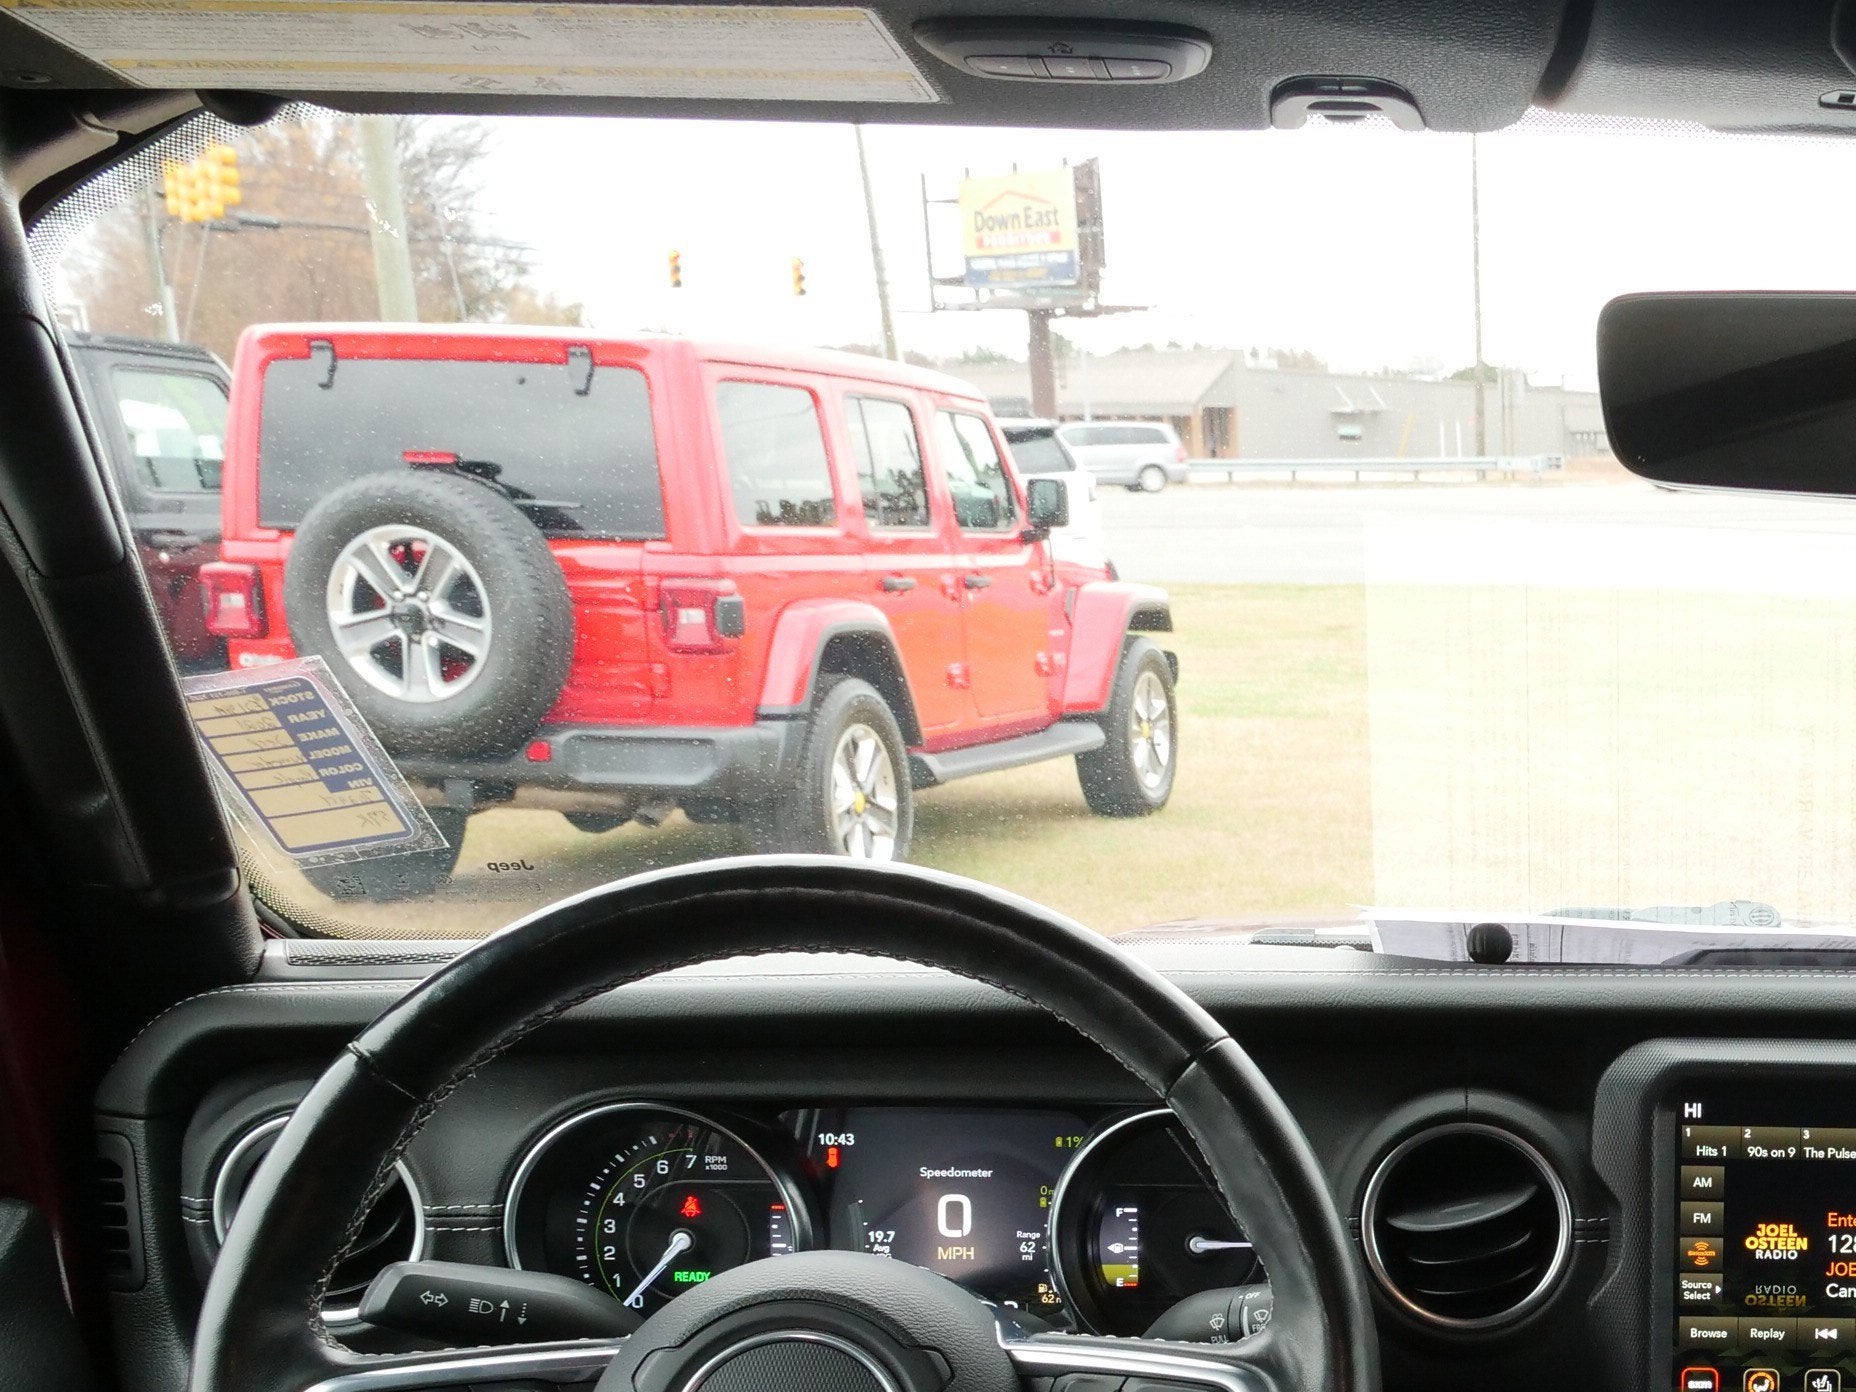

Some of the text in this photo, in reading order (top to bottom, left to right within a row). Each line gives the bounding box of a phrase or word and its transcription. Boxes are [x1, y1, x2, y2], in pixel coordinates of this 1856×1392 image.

[974, 206, 1059, 232] Down East
[1684, 1102, 1702, 1118] HI
[1685, 1128, 1691, 1137] 1
[1744, 1129, 1751, 1138] 2
[1803, 1130, 1810, 1139] 3
[818, 1133, 855, 1145] 10:43
[1696, 1145, 1727, 1157] Hits 1
[1747, 1146, 1796, 1158] 90s on 9
[1803, 1147, 1856, 1159] The Pulse
[685, 1154, 697, 1169] 7
[704, 1155, 727, 1164] RPM
[656, 1159, 669, 1174] 6
[919, 1167, 993, 1180] Speedometer
[633, 1174, 646, 1188] 5
[1693, 1177, 1712, 1187] AM
[1040, 1185, 1048, 1195] 0
[612, 1192, 626, 1206] 4
[937, 1193, 972, 1238] 0
[1115, 1207, 1124, 1217] F
[1693, 1213, 1711, 1223] FM
[603, 1219, 616, 1234] 3
[1756, 1224, 1798, 1237] JOEL
[868, 1230, 896, 1243] 19.7
[1016, 1231, 1041, 1240] Range
[873, 1243, 890, 1254] Avg
[1019, 1241, 1036, 1253] 62
[1745, 1237, 1808, 1250] OSTEEN
[603, 1245, 616, 1260] 2
[937, 1246, 975, 1260] MPH
[1021, 1253, 1033, 1261] mi
[1755, 1250, 1798, 1260] RADIO
[612, 1273, 621, 1288] 1
[674, 1271, 711, 1283] READY
[1115, 1277, 1124, 1287] E
[1681, 1280, 1712, 1289] Source
[1825, 1283, 1856, 1298] Can
[632, 1294, 644, 1309] 0
[1041, 1293, 1055, 1304] 62
[1684, 1291, 1710, 1300] Select
[1690, 1328, 1727, 1338] Browse
[1750, 1328, 1785, 1341] Replay
